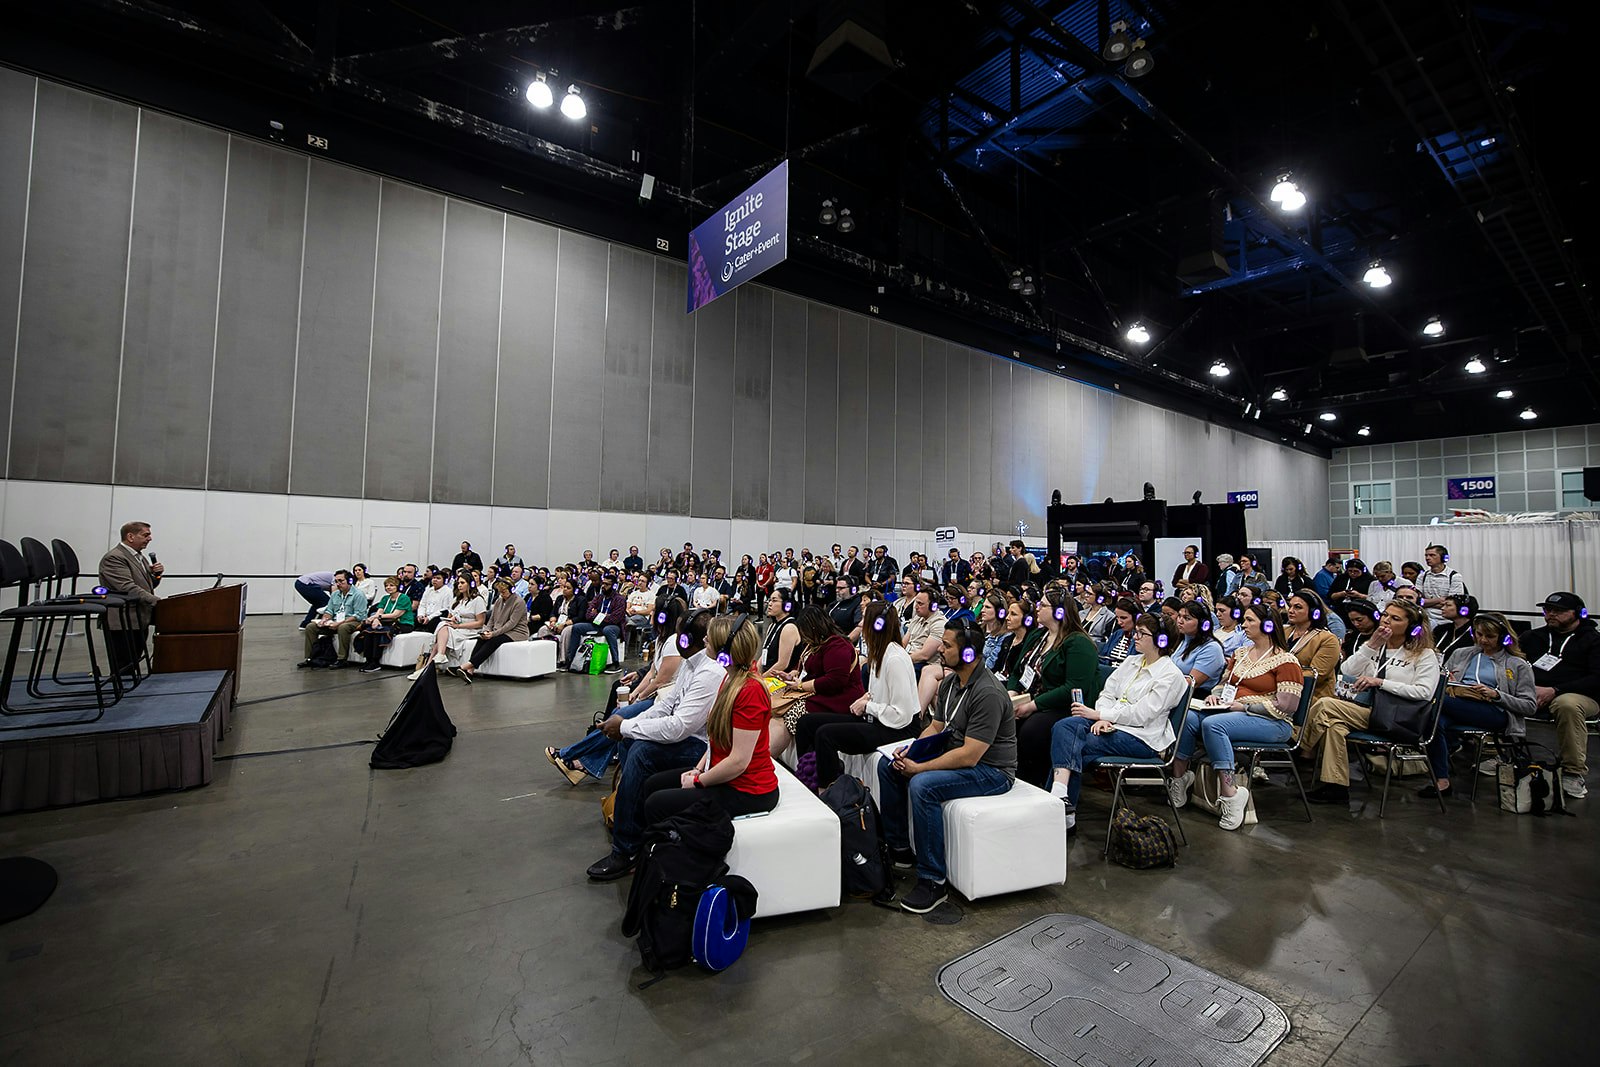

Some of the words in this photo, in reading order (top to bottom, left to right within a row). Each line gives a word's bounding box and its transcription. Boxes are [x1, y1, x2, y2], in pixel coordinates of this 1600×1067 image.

[310, 136, 326, 148] 23
[724, 192, 763, 232] Ignite
[725, 220, 761, 255] Stage
[657, 240, 668, 249] 22
[734, 233, 780, 268] Cater+Event
[1460, 480, 1494, 491] 1500
[1235, 493, 1257, 502] 1600
